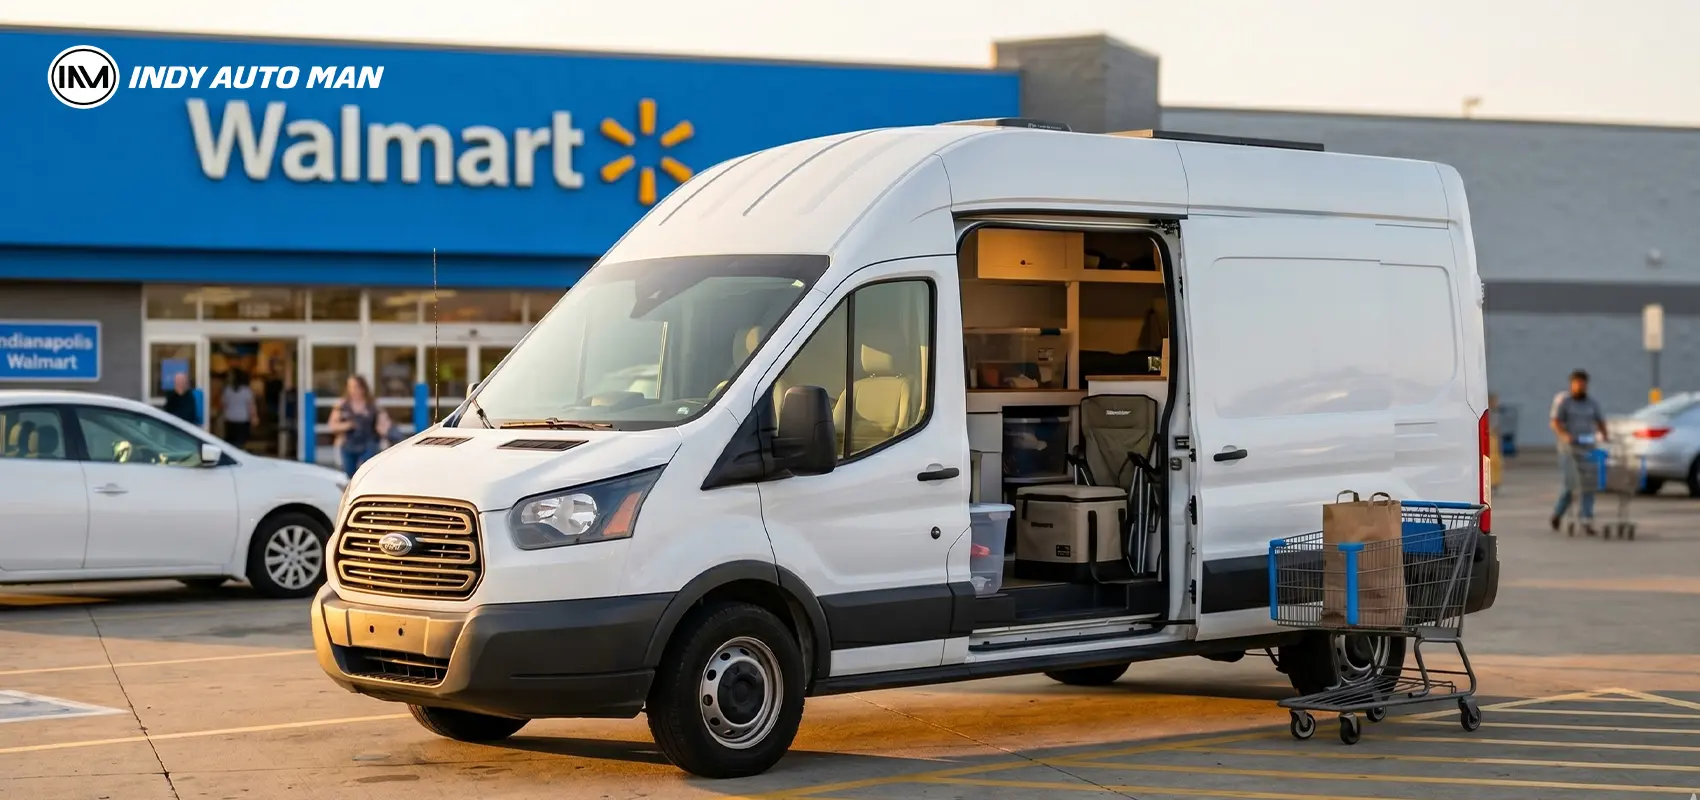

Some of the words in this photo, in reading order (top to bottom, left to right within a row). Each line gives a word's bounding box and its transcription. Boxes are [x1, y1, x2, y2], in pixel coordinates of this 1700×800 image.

[186, 98, 584, 189] Walmart
[0, 332, 93, 353] ndianapolis
[6, 352, 78, 370] Walmart
